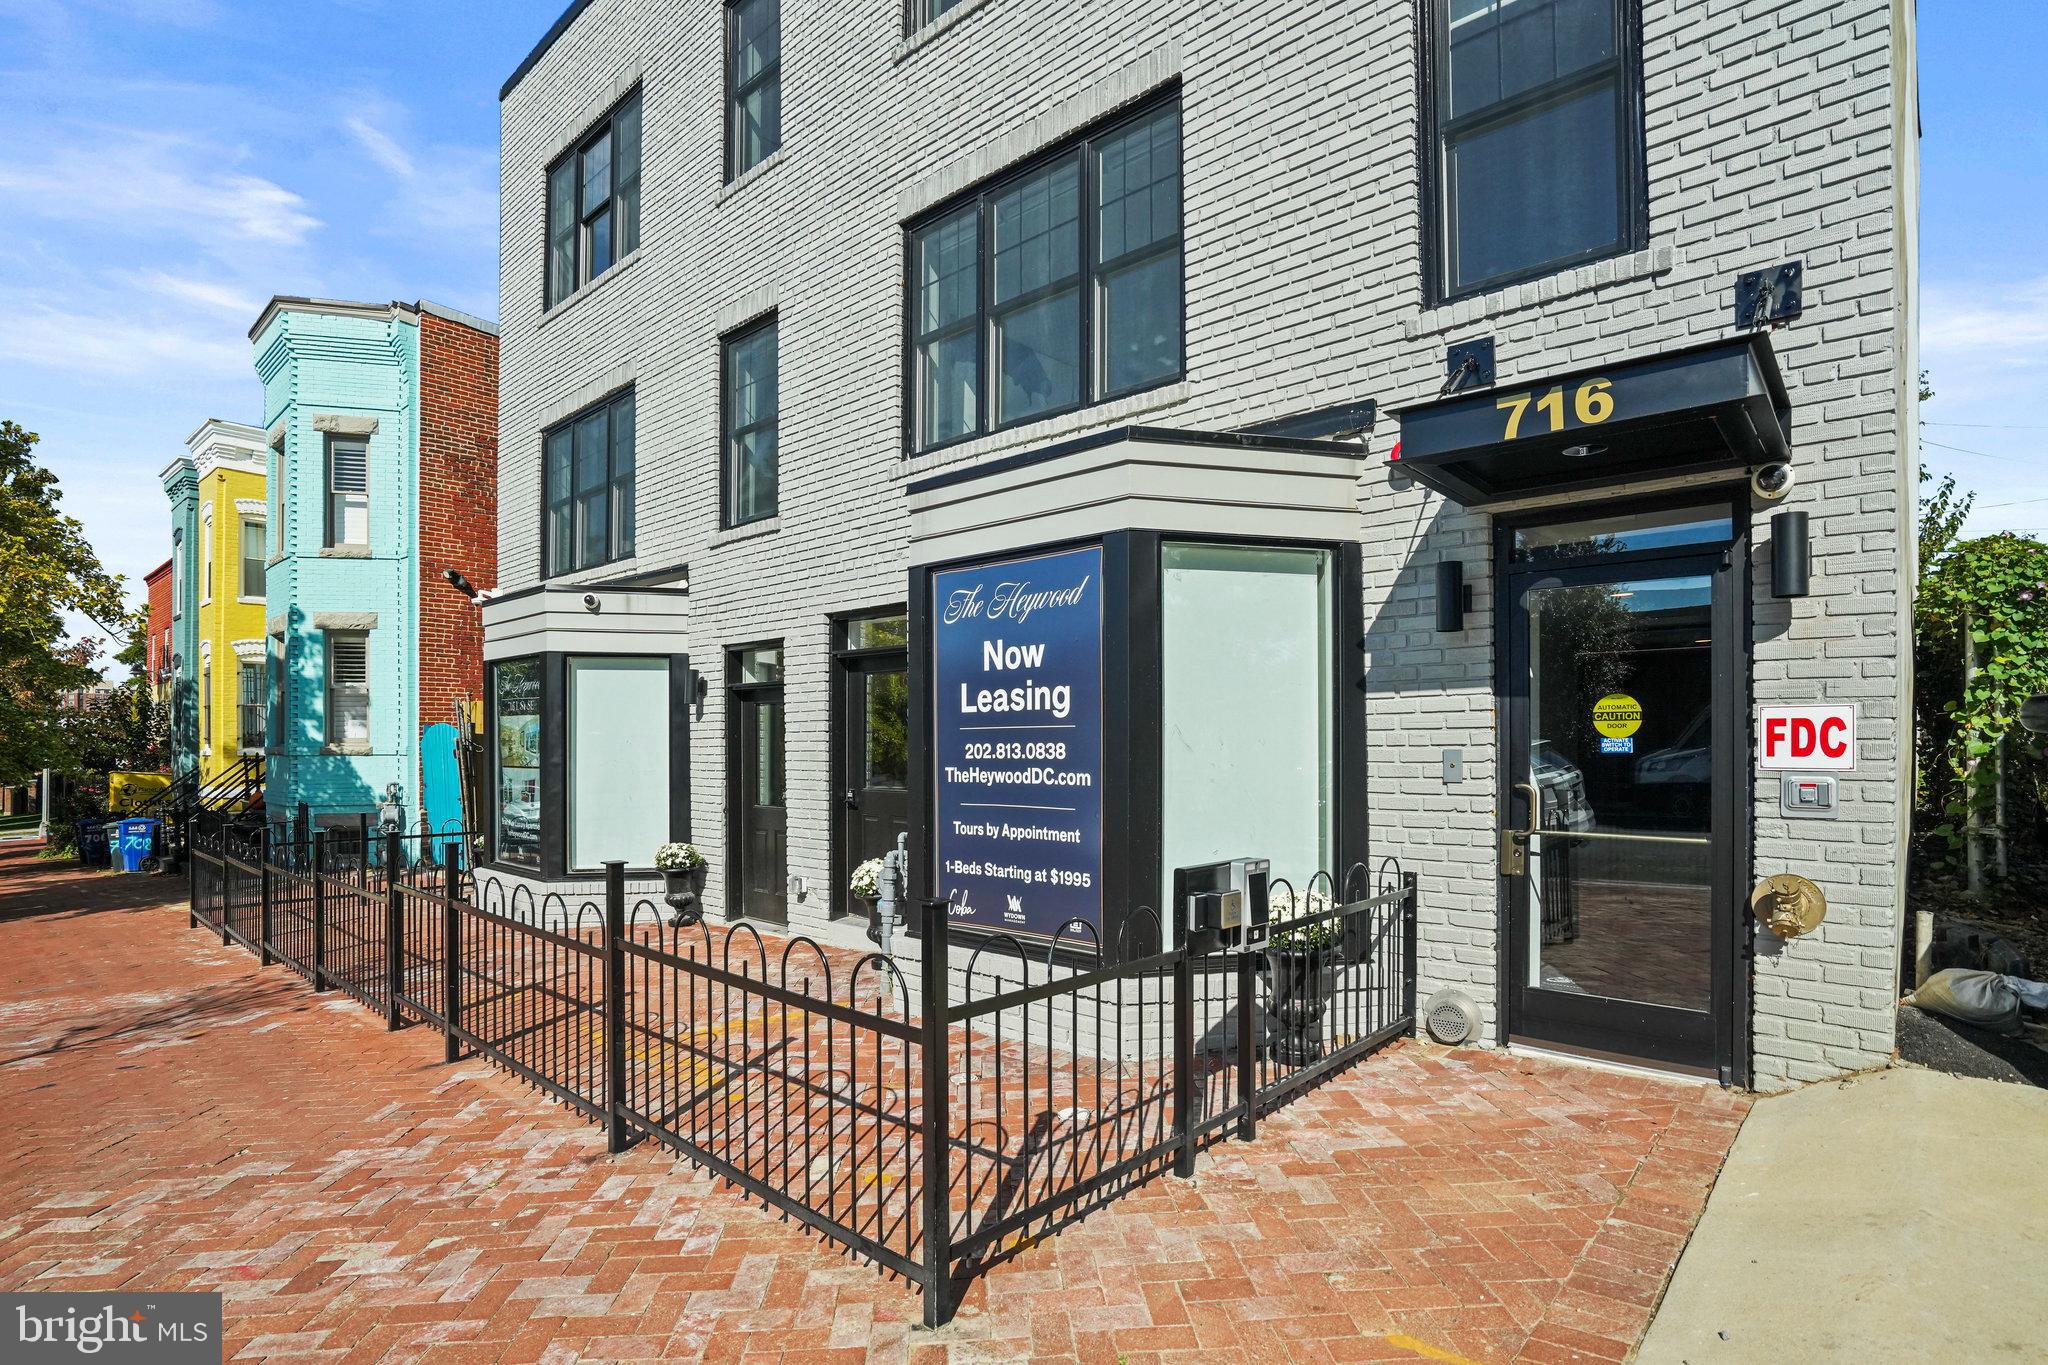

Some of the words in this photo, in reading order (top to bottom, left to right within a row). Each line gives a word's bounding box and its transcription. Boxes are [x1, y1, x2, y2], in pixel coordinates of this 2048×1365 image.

[1496, 377, 1614, 441] 716
[943, 583, 984, 624] The
[987, 575, 1090, 624] Heywood
[983, 639, 1045, 671] Now
[960, 679, 1071, 718] Leasing
[1594, 712, 1641, 721] CAUTION
[1766, 716, 1847, 758] FDC
[965, 743, 1066, 760] 202.813.0838
[945, 767, 1091, 786] TheHeywoodDC.com
[119, 798, 171, 807] Cloes
[953, 821, 984, 836] Tours
[986, 822, 999, 839] by
[1002, 823, 1081, 843] Appointment
[945, 860, 982, 876] 1-Beds
[984, 862, 1032, 883] Starting
[1034, 868, 1047, 882] at
[1051, 868, 1091, 888] $1995
[1003, 911, 1026, 920] WYDOWN
